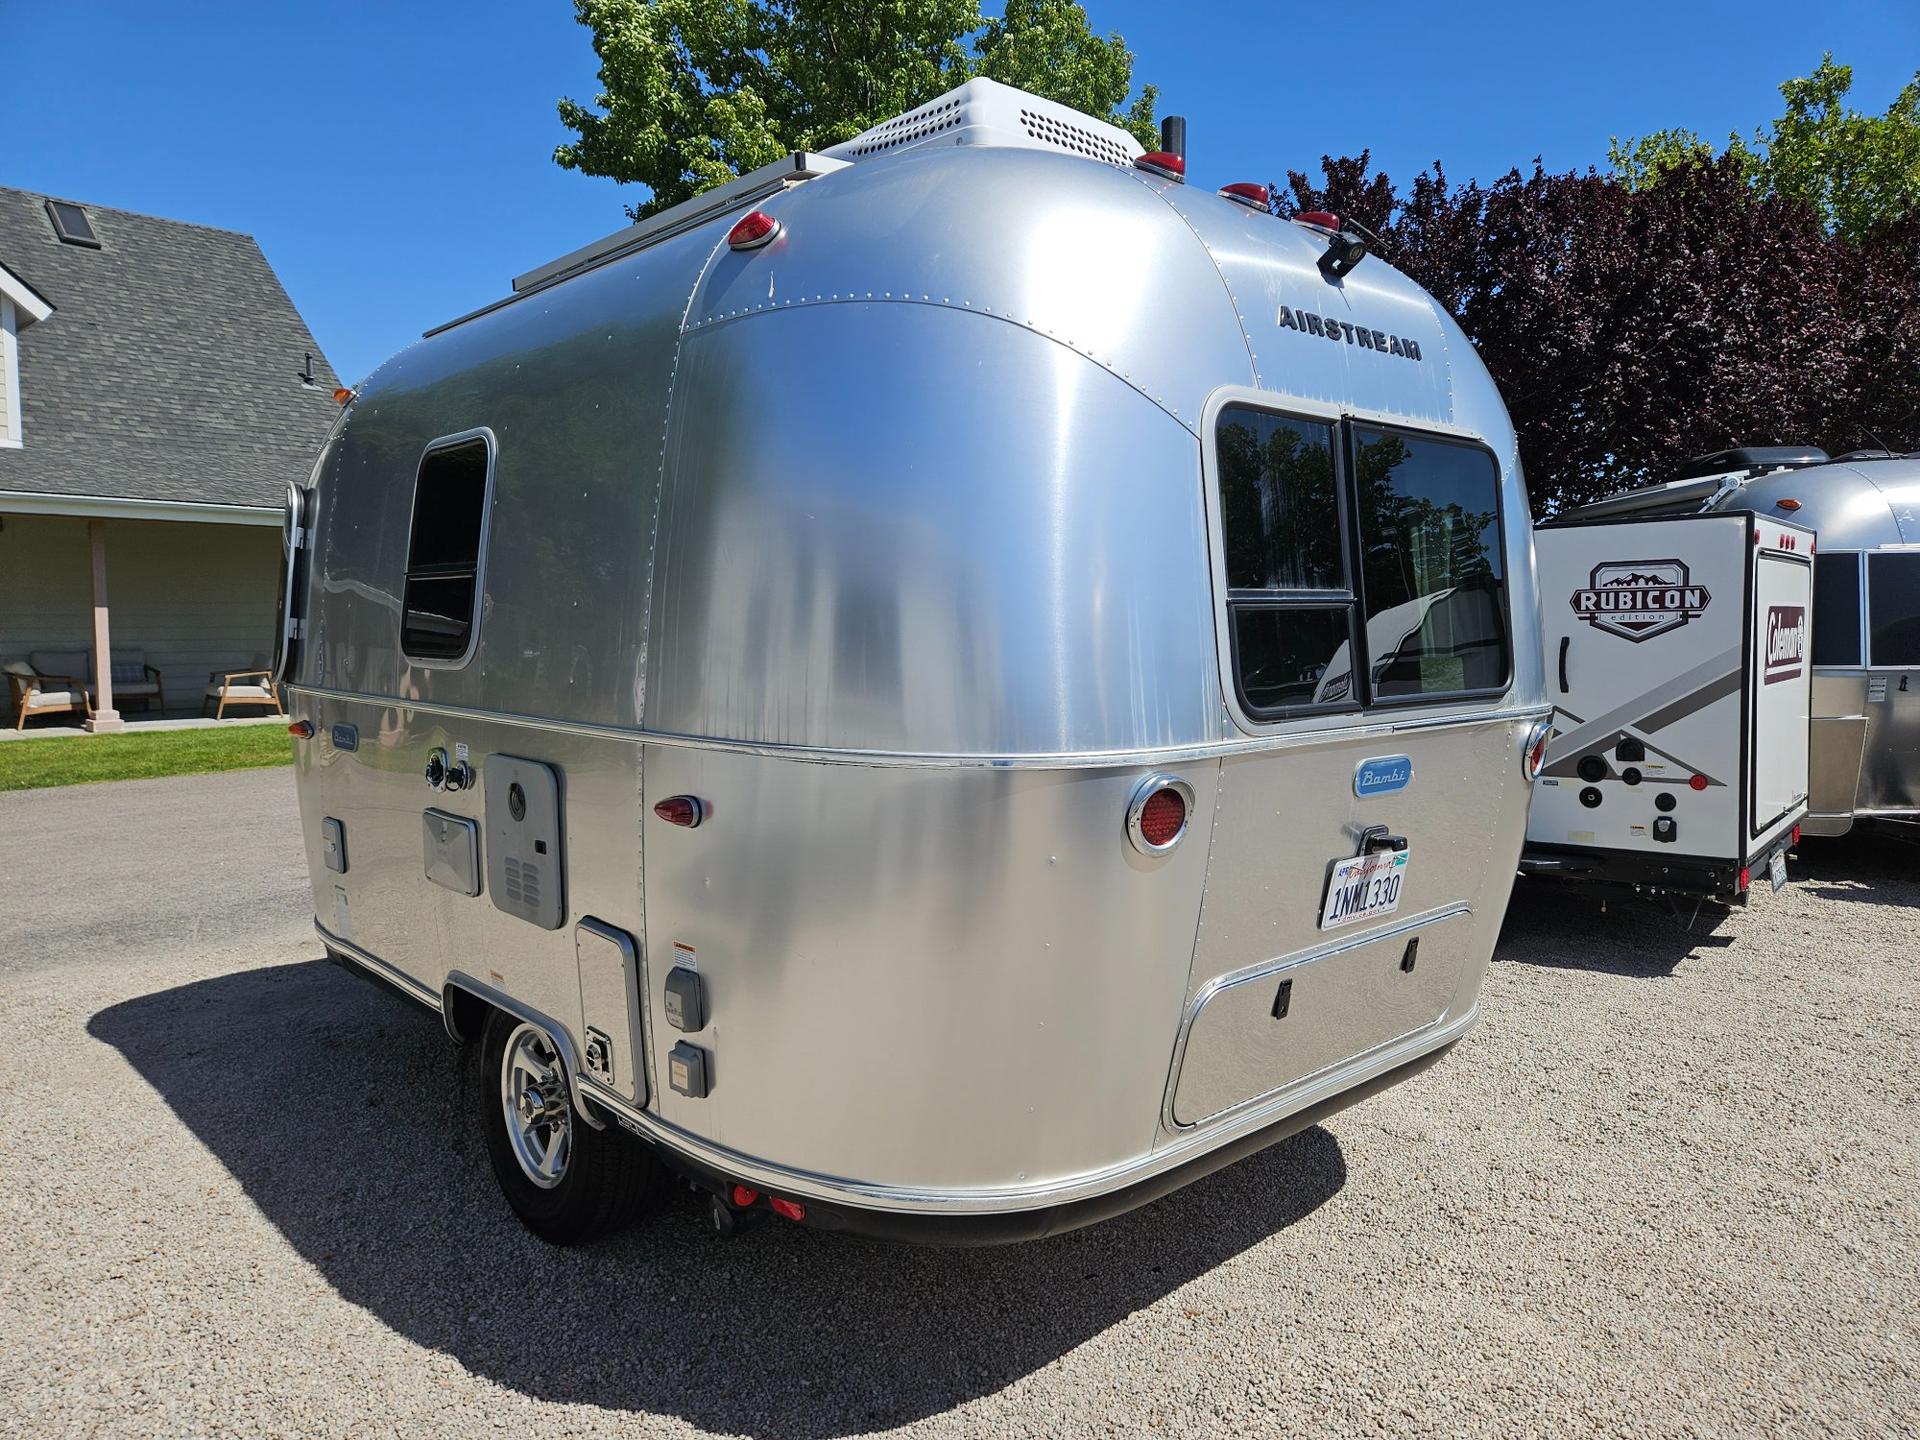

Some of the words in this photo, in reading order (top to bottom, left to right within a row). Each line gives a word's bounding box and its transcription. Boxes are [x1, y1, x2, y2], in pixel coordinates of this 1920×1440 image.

[1278, 305, 1422, 361] AIRSTREAM
[1580, 589, 1701, 611] RUBICON
[1361, 768, 1406, 787] Bambi
[1329, 874, 1401, 920] 1NM1330
